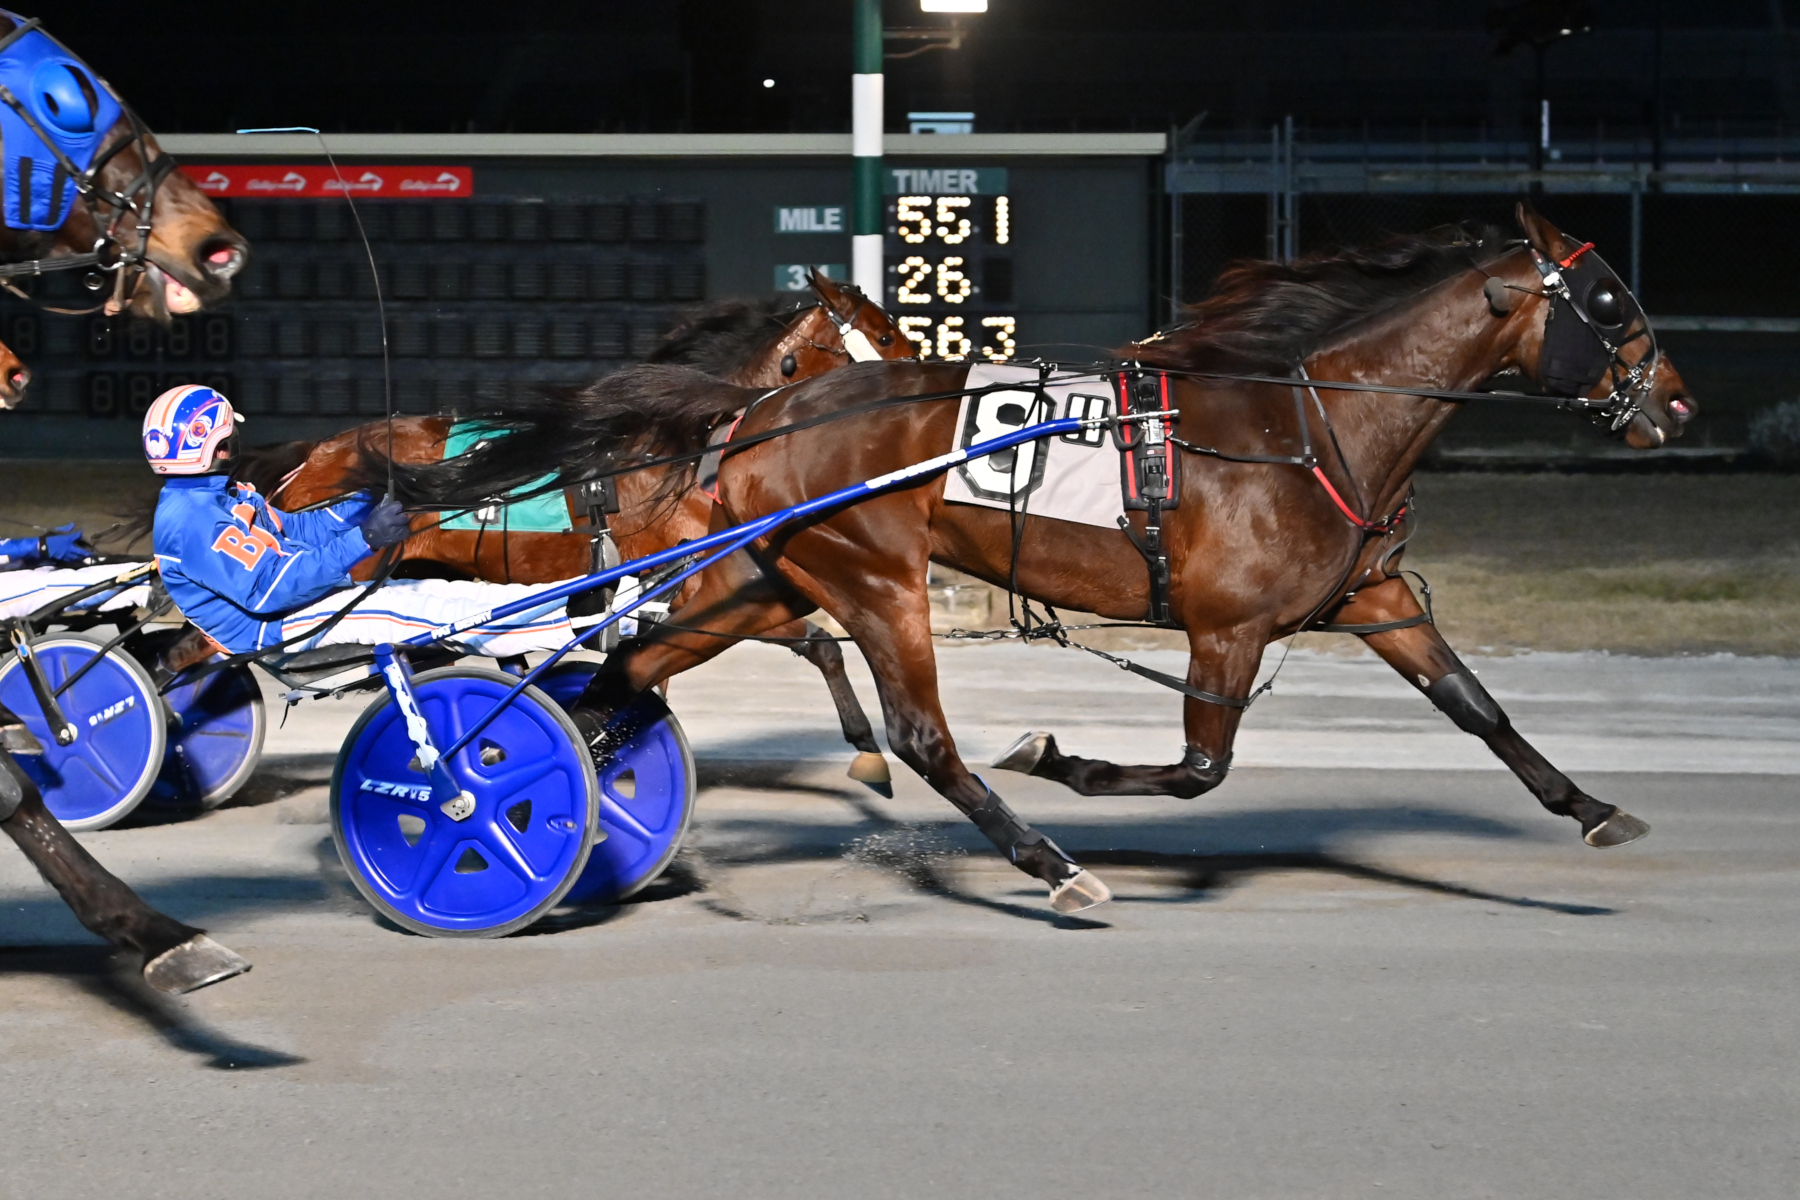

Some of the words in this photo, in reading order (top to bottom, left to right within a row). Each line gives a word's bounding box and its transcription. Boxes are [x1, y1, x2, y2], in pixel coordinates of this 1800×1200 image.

[892, 169, 978, 194] TIMER
[779, 207, 842, 231] MILE
[897, 255, 972, 304] 26
[957, 382, 1057, 504] 8
[211, 525, 267, 572] B
[430, 622, 454, 640] PAT
[359, 778, 410, 798] LZR
